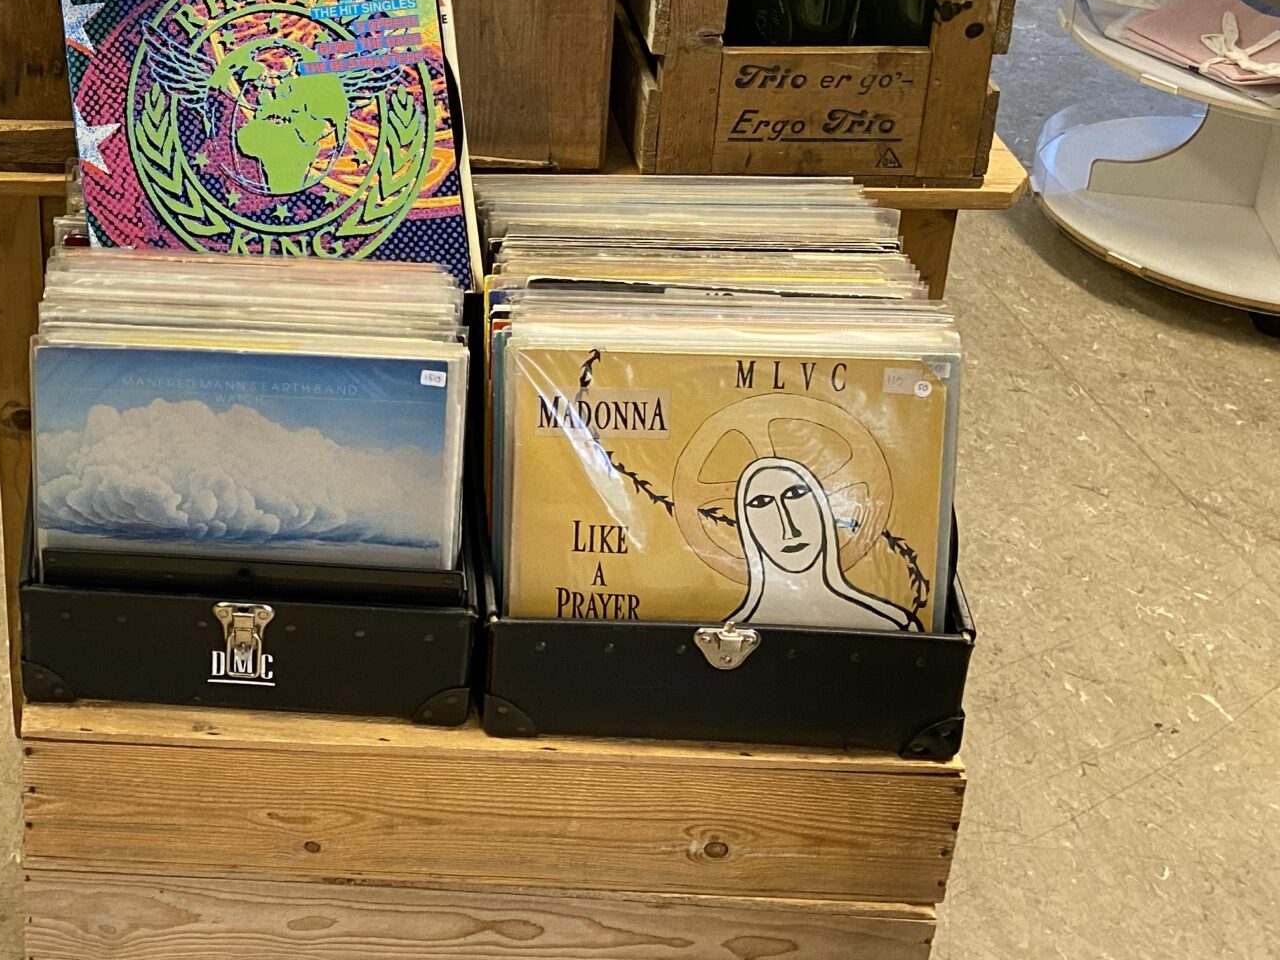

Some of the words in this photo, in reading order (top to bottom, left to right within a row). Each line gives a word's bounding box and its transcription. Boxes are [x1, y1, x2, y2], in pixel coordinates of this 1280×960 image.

[313, 4, 338, 19] THE
[340, 3, 358, 15] HIT
[734, 64, 808, 89] Trio
[819, 73, 852, 89] er
[731, 109, 806, 141] Ergo
[822, 109, 896, 134] Trio
[228, 226, 344, 258] KING
[918, 383, 929, 392] 50
[537, 395, 669, 431] MADONNA
[572, 520, 629, 554] LIKE
[591, 561, 608, 586] A
[556, 587, 641, 620] PRAYER
[211, 650, 274, 680] DMC
